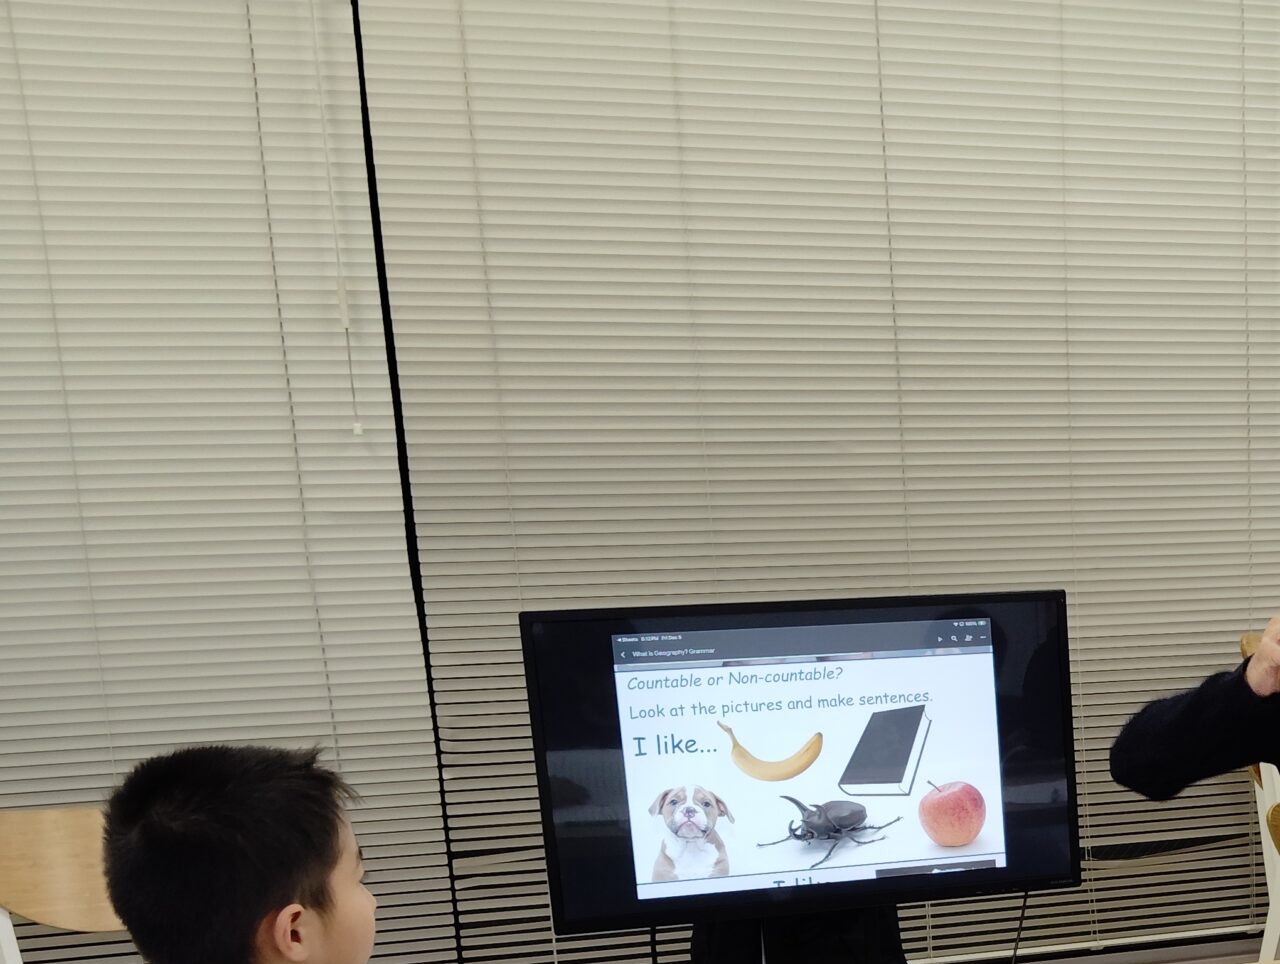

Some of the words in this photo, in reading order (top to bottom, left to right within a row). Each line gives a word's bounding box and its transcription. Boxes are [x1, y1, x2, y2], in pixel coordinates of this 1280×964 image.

[654, 649, 688, 657] Geography?
[627, 673, 702, 690] Countable
[707, 675, 724, 686] or
[728, 666, 843, 685] Non-countable?
[629, 704, 666, 719] Look
[669, 704, 686, 717] at
[690, 701, 717, 716] the
[721, 699, 783, 717] pictures
[787, 695, 813, 710] and
[817, 693, 855, 708] make
[858, 691, 933, 706] sentences.
[632, 736, 647, 757] I
[656, 733, 717, 755] like...
